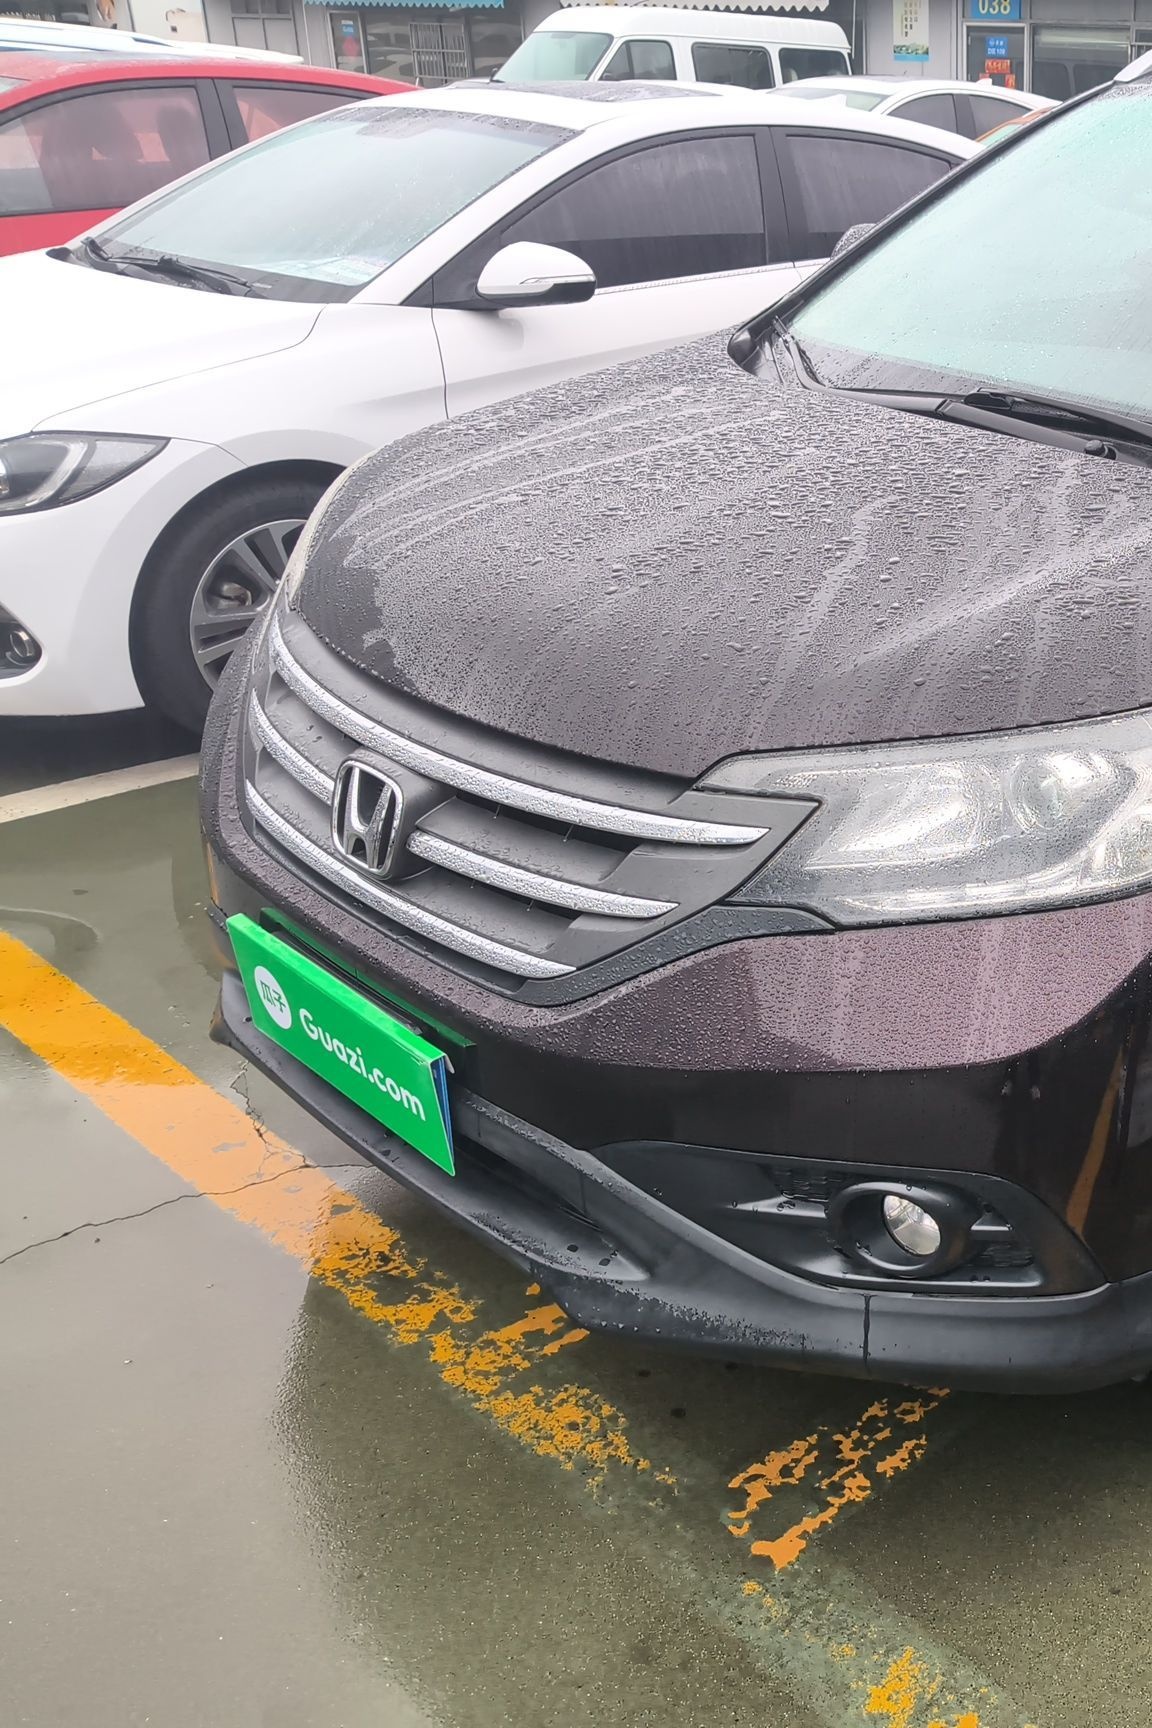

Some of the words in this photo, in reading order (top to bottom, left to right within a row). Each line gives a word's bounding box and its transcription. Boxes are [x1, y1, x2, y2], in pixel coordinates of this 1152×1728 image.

[978, 0, 1011, 15] 038
[259, 978, 286, 1013] 瓜子
[299, 1008, 426, 1121] Guazi.com
